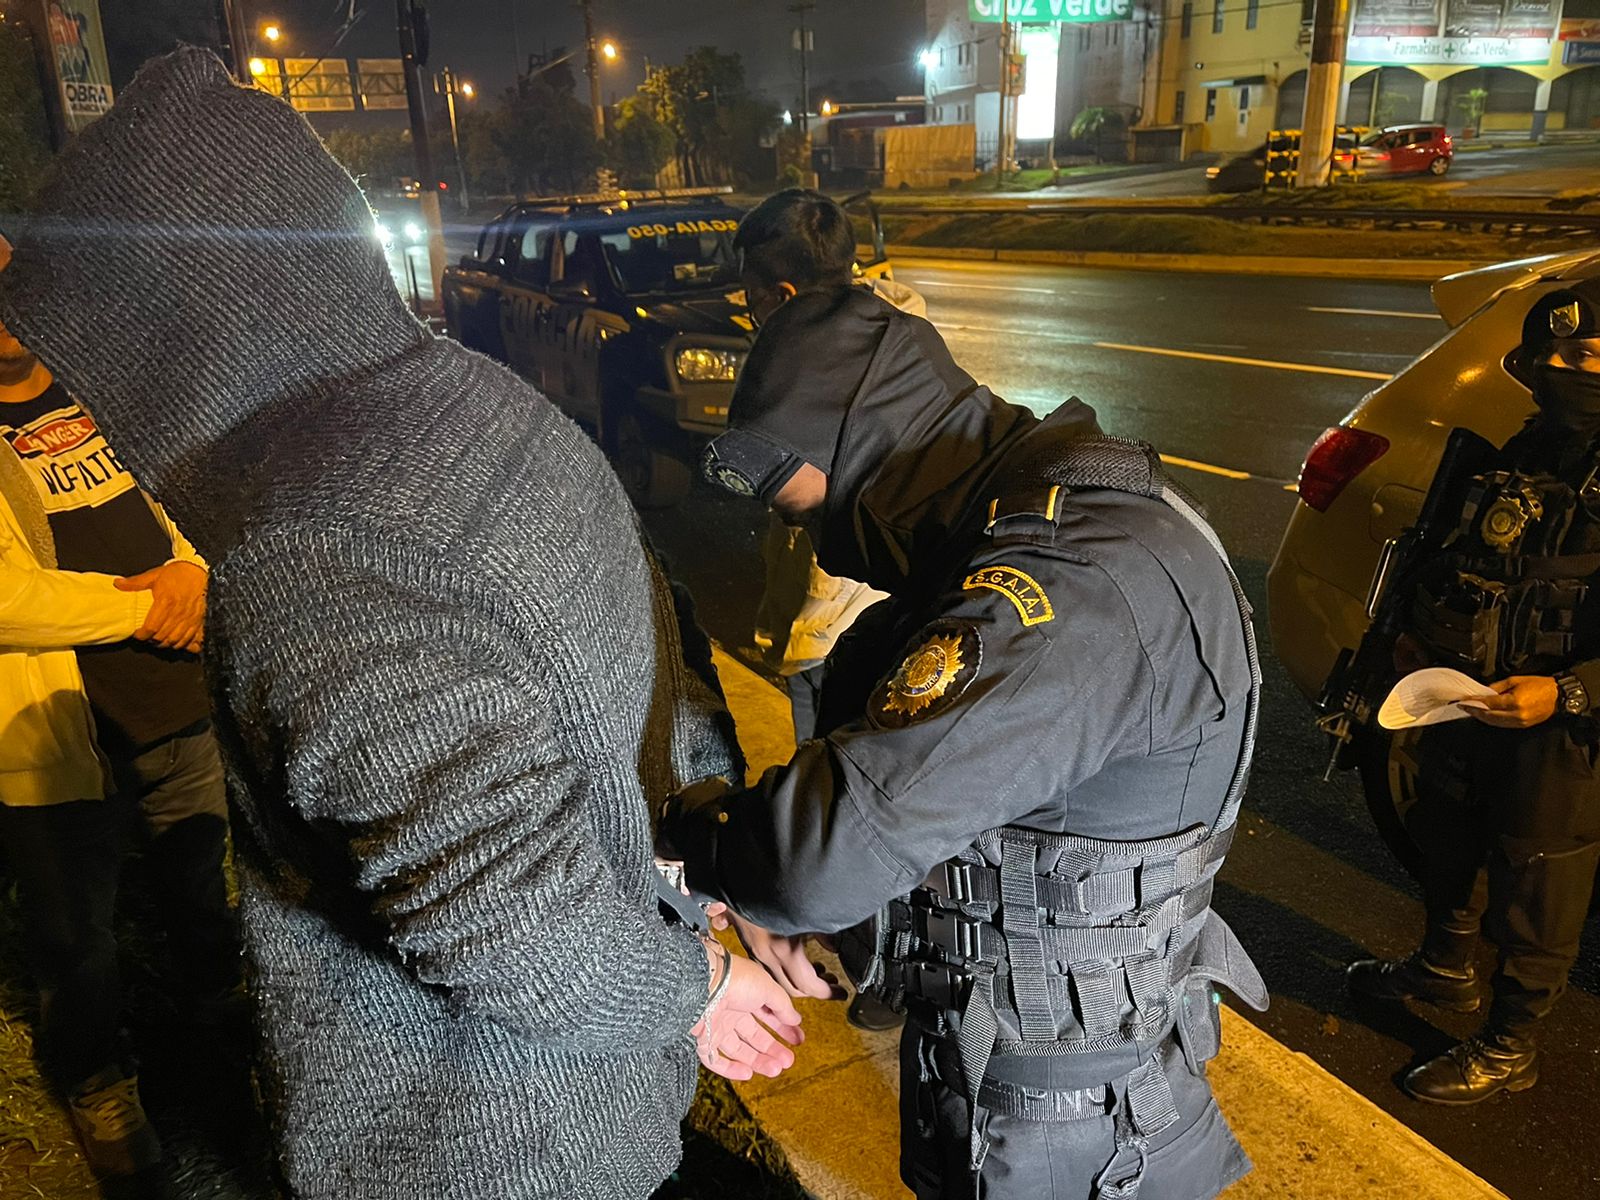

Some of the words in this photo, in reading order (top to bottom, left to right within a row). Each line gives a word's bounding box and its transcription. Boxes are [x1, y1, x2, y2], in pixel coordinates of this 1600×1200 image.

[975, 0, 1037, 16] Cruz
[1049, 0, 1129, 16] Verde
[1394, 41, 1440, 55] Farmacias
[65, 84, 108, 103] OBRA
